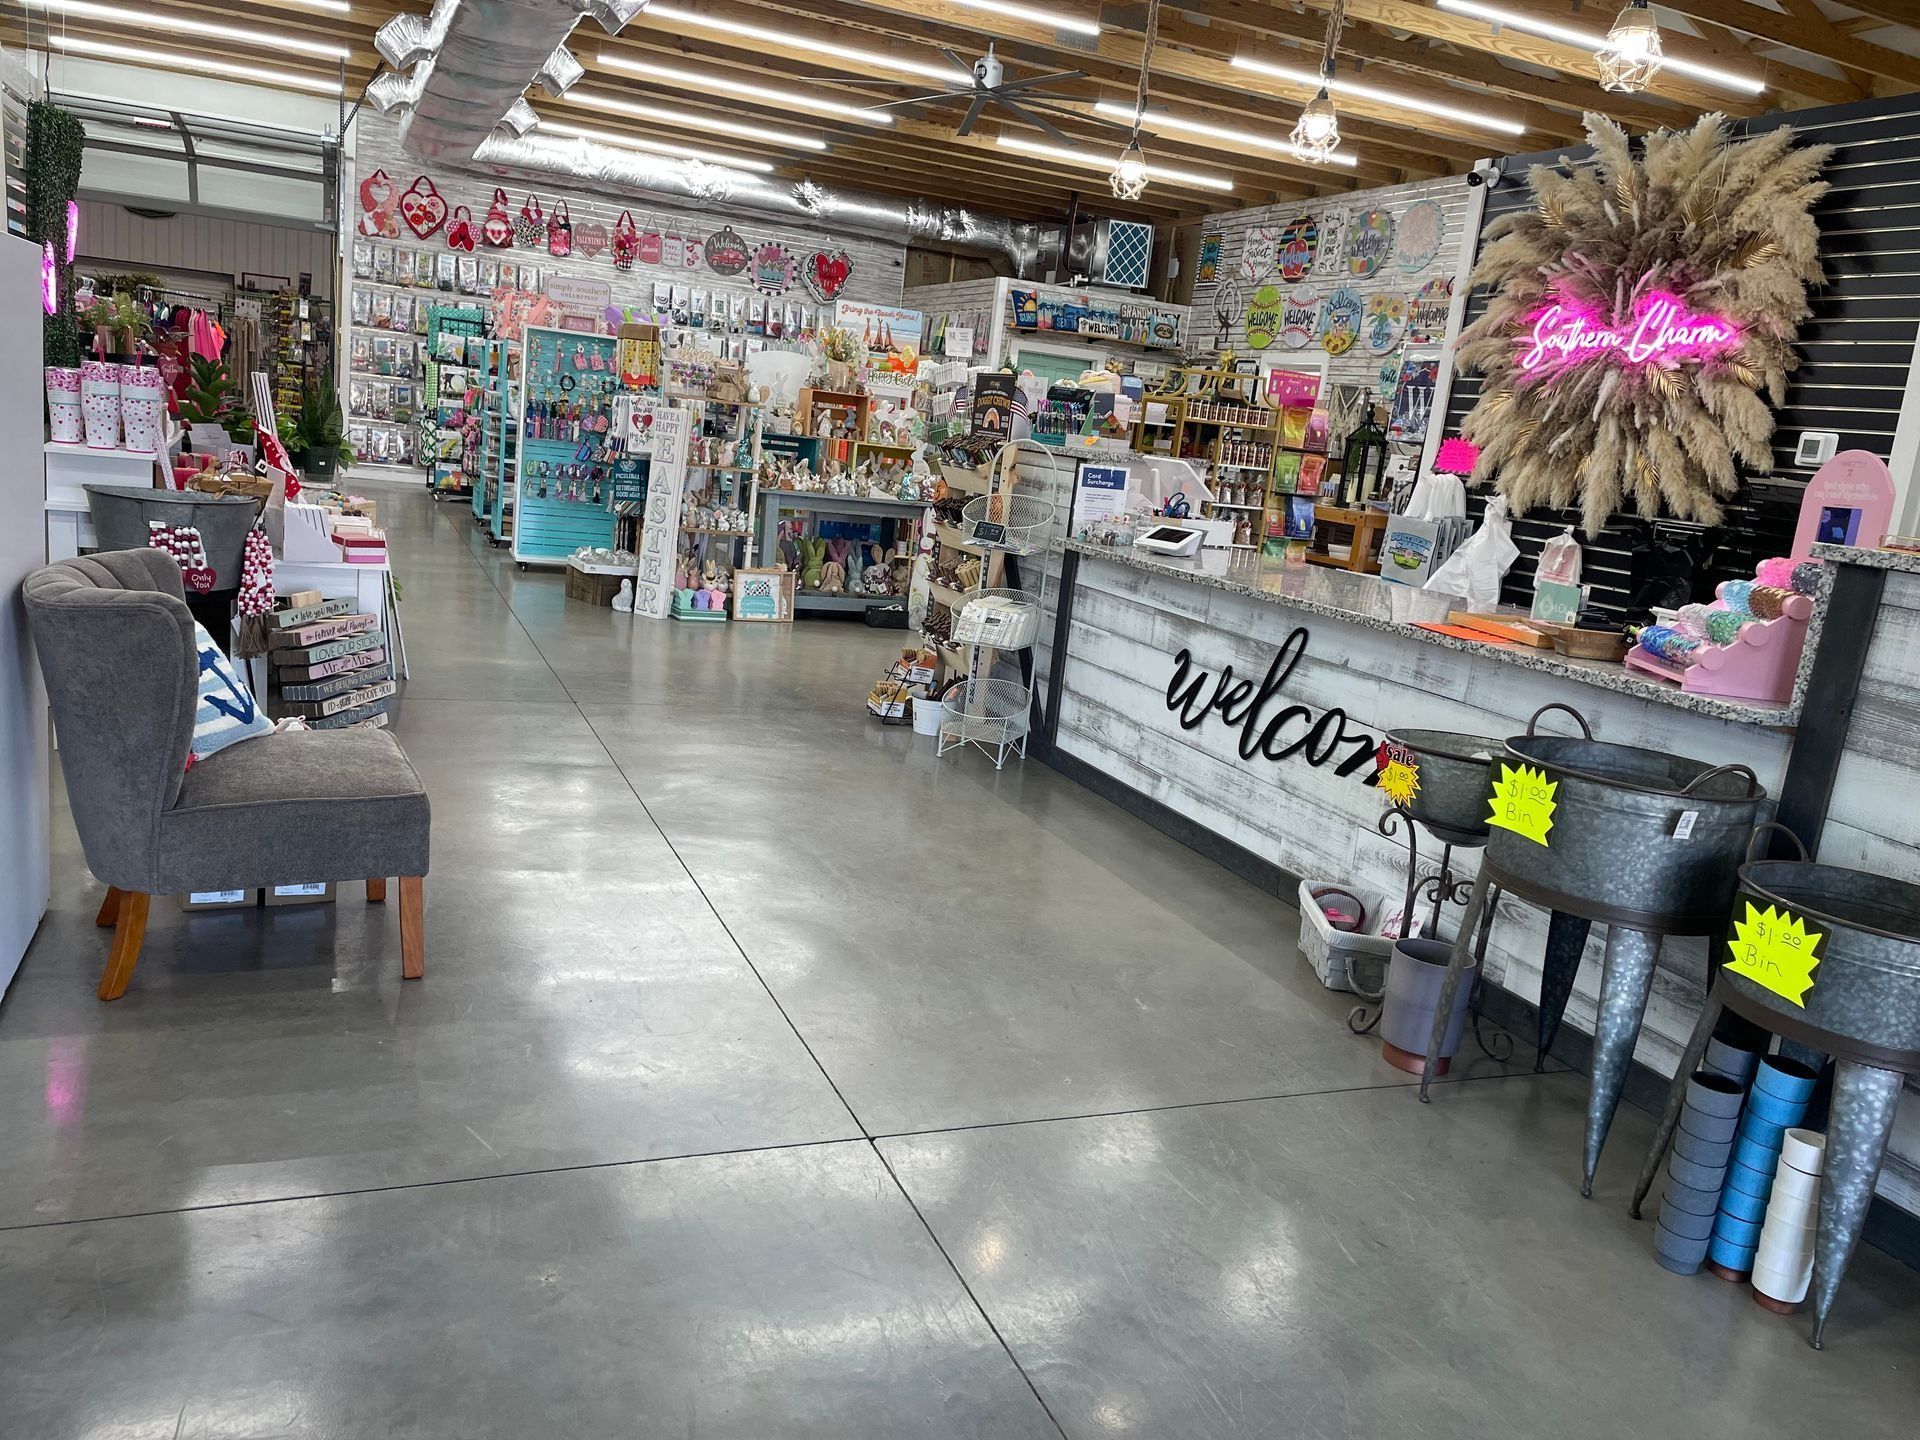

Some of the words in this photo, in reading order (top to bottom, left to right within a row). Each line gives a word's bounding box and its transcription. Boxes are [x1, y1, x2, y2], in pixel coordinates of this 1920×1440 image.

[710, 236, 744, 251] Welcome
[1247, 310, 1278, 332] WELCOME
[1283, 309, 1316, 331] WELCOME
[1416, 302, 1449, 328] Welcome
[1088, 323, 1119, 335] WELCOME
[1521, 304, 1624, 369] Southern
[1622, 299, 1730, 363] Charm
[868, 369, 893, 384] Happy
[656, 411, 675, 420] HAVE
[655, 421, 679, 434] HAPPY
[1087, 472, 1102, 480] Card
[1087, 479, 1114, 488] Surcharge
[636, 434, 676, 614] EASTER
[191, 573, 212, 583] Only
[193, 580, 210, 588] You
[315, 645, 336, 661] LOVE
[337, 641, 355, 655] OUR
[356, 635, 380, 650] STORY
[321, 662, 340, 676] Mr.
[351, 655, 374, 668] Mrs.
[334, 676, 359, 691] BELONG
[360, 666, 388, 683] TOGETHER
[355, 687, 378, 704] CHOOSE
[379, 683, 392, 696] YOU
[1387, 744, 1414, 766] sale
[1506, 779, 1548, 804] $1.00
[1505, 802, 1534, 827] Bin
[1755, 921, 1801, 949] $1.00
[1741, 943, 1784, 978] Bin
